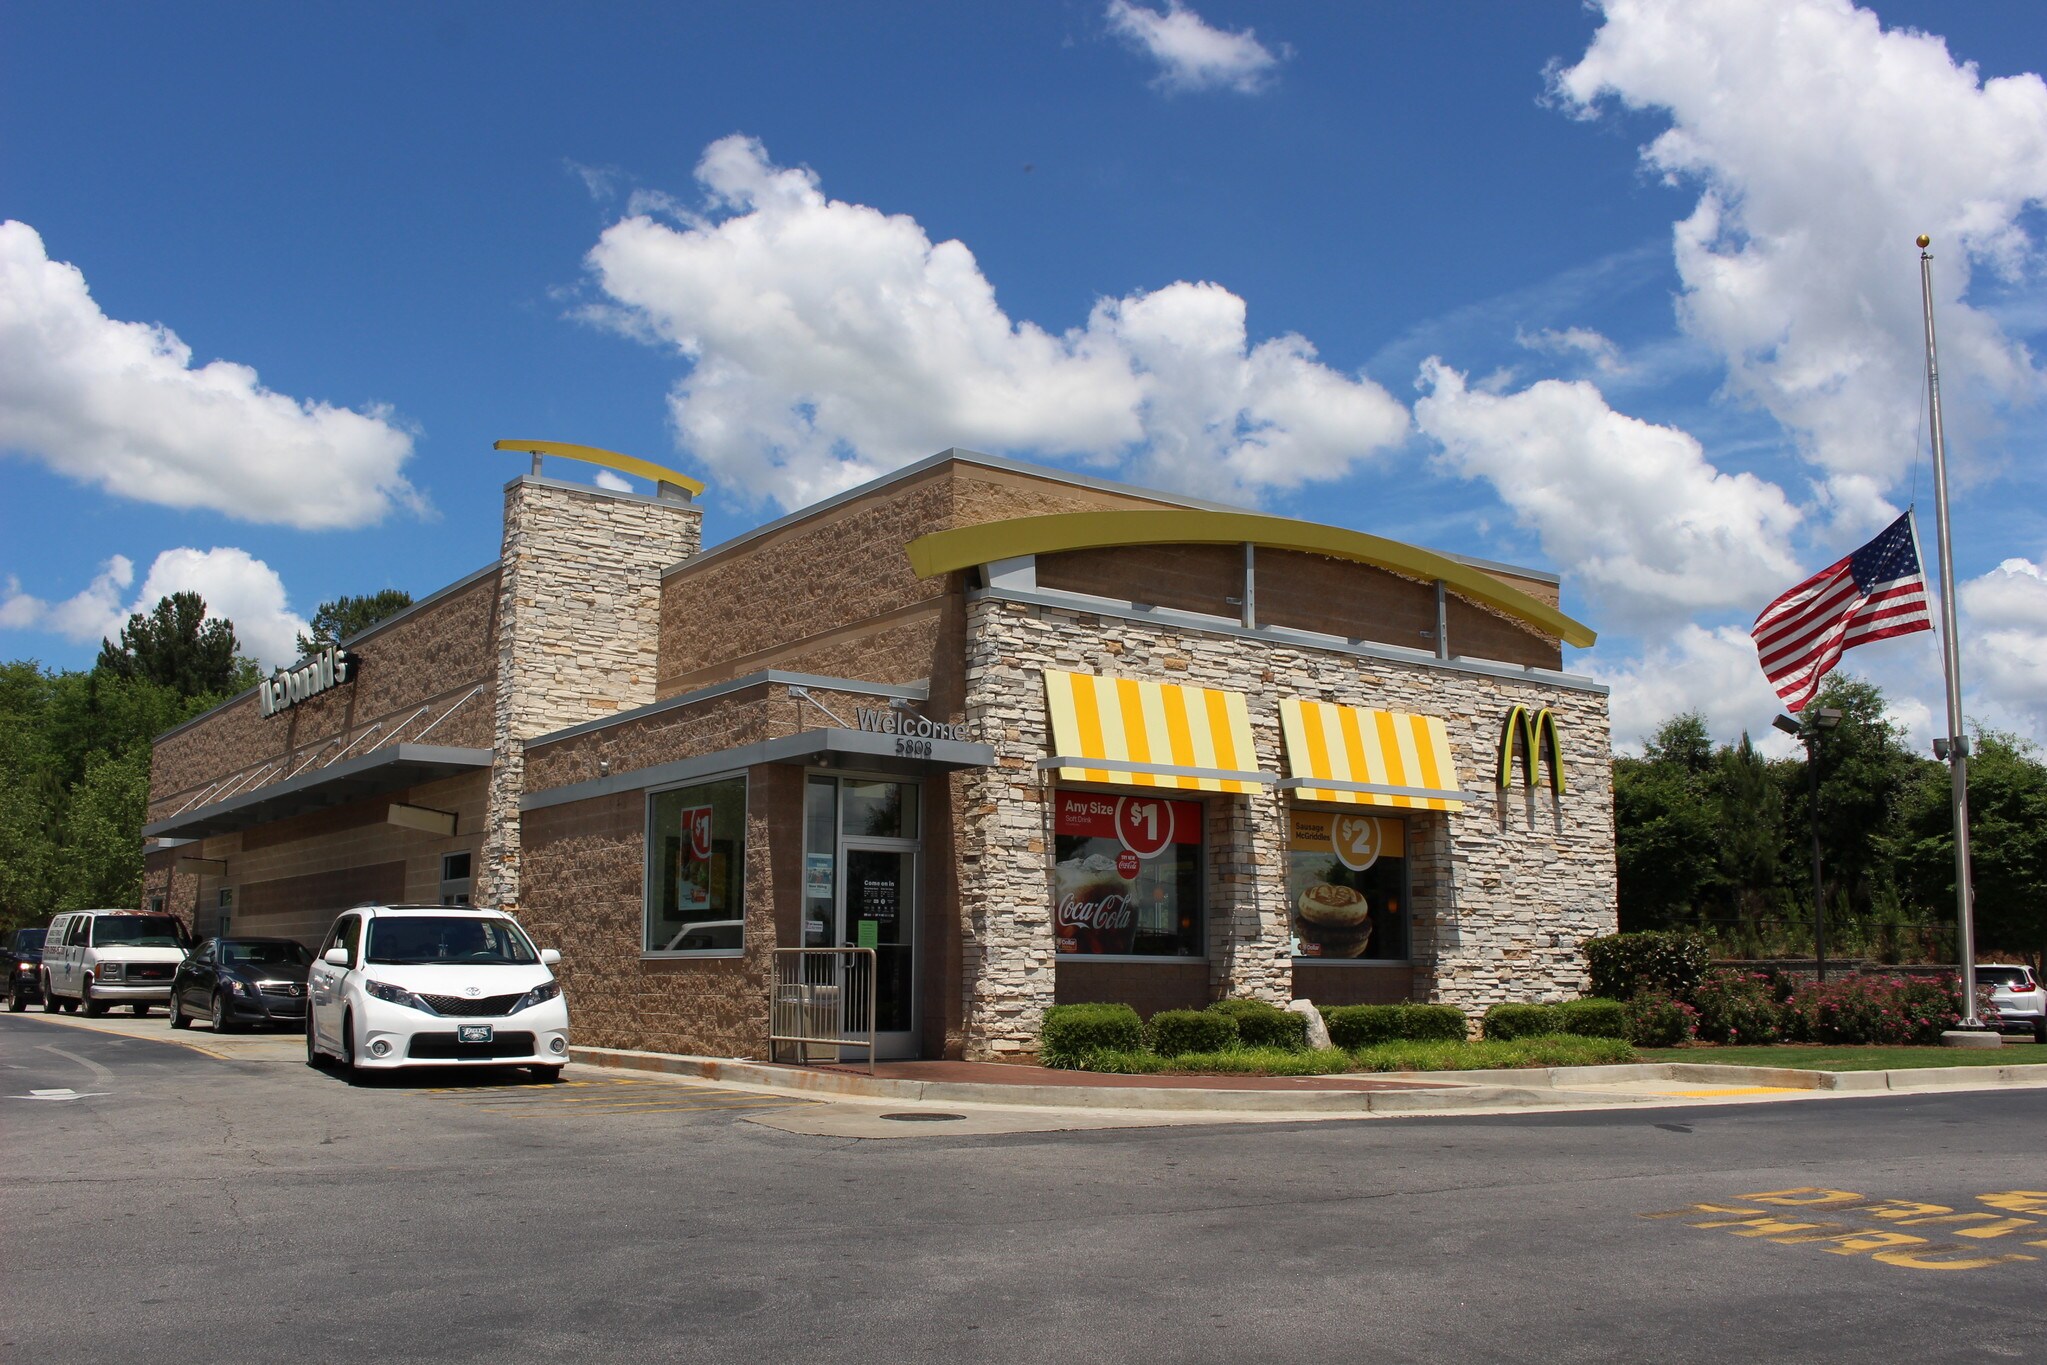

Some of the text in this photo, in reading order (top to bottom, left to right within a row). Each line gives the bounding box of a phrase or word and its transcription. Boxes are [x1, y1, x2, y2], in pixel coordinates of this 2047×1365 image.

[259, 645, 346, 718] McDonald's
[856, 707, 966, 741] Welcome
[895, 737, 932, 755] 5808
[1065, 800, 1114, 815] Any Size
[1078, 815, 1092, 823] Drink
[695, 815, 709, 847] $1
[1130, 802, 1158, 841] $1
[1296, 822, 1324, 832] Sausage
[1296, 831, 1330, 841] McGriddles
[1342, 818, 1370, 854] $2
[863, 879, 880, 887] Come
[1058, 892, 1132, 930] Coca-Cola
